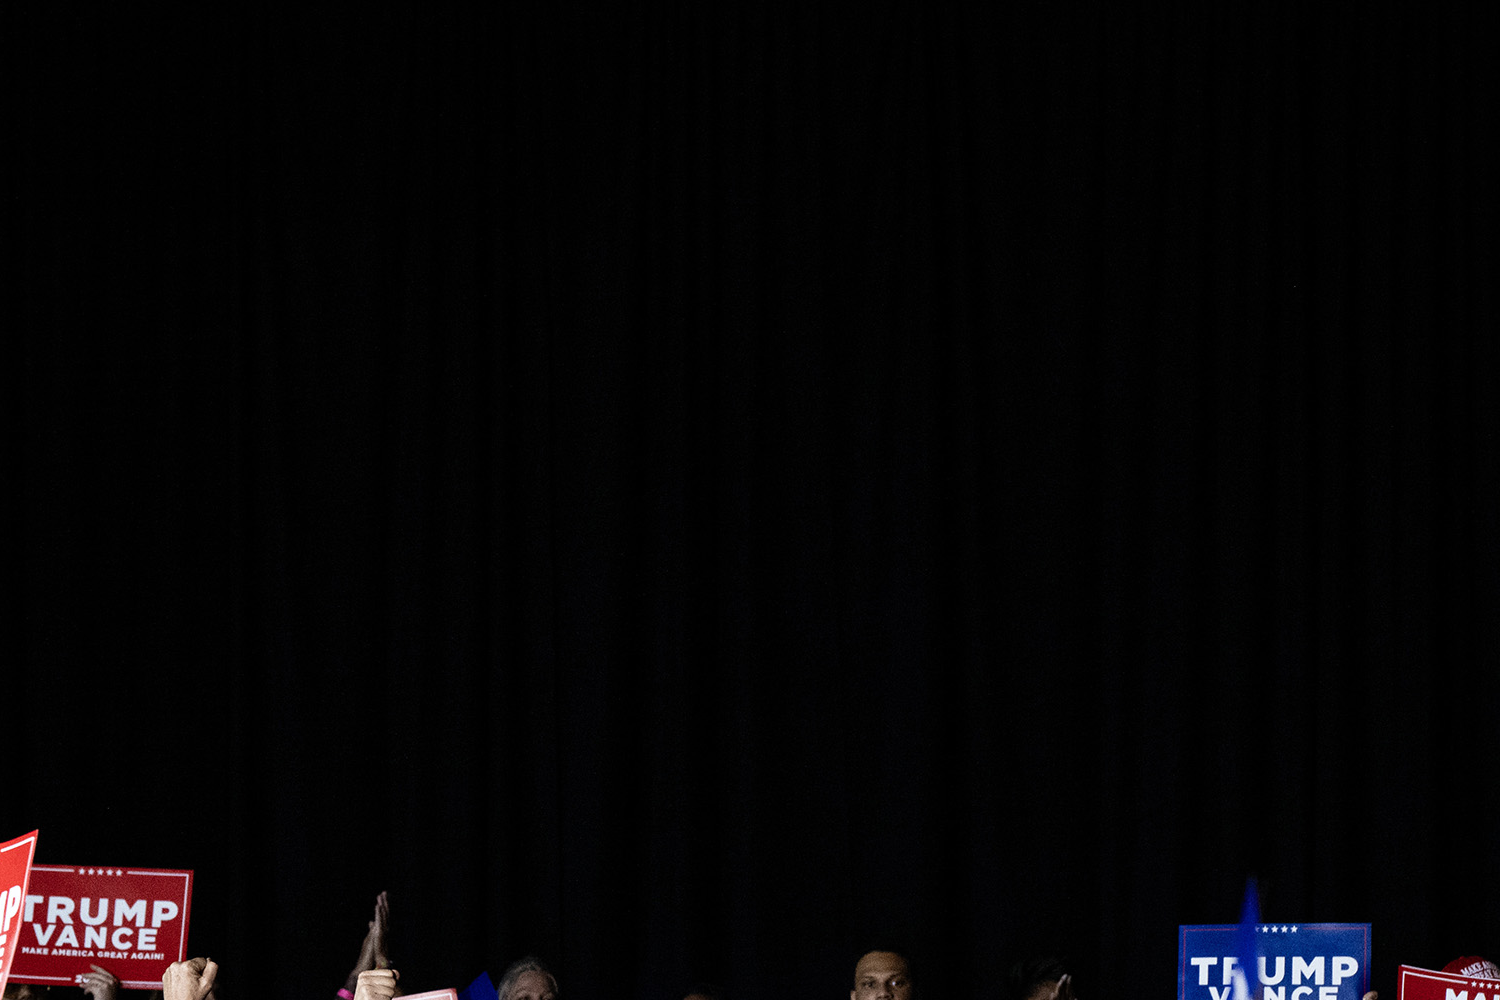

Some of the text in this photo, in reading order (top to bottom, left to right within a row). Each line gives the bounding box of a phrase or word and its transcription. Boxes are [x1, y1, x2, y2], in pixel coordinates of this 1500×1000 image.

[23, 895, 179, 928] TRUMP
[32, 924, 159, 951] VANCE
[22, 947, 165, 960] MAKE AMERICA GREAT AGAIN!
